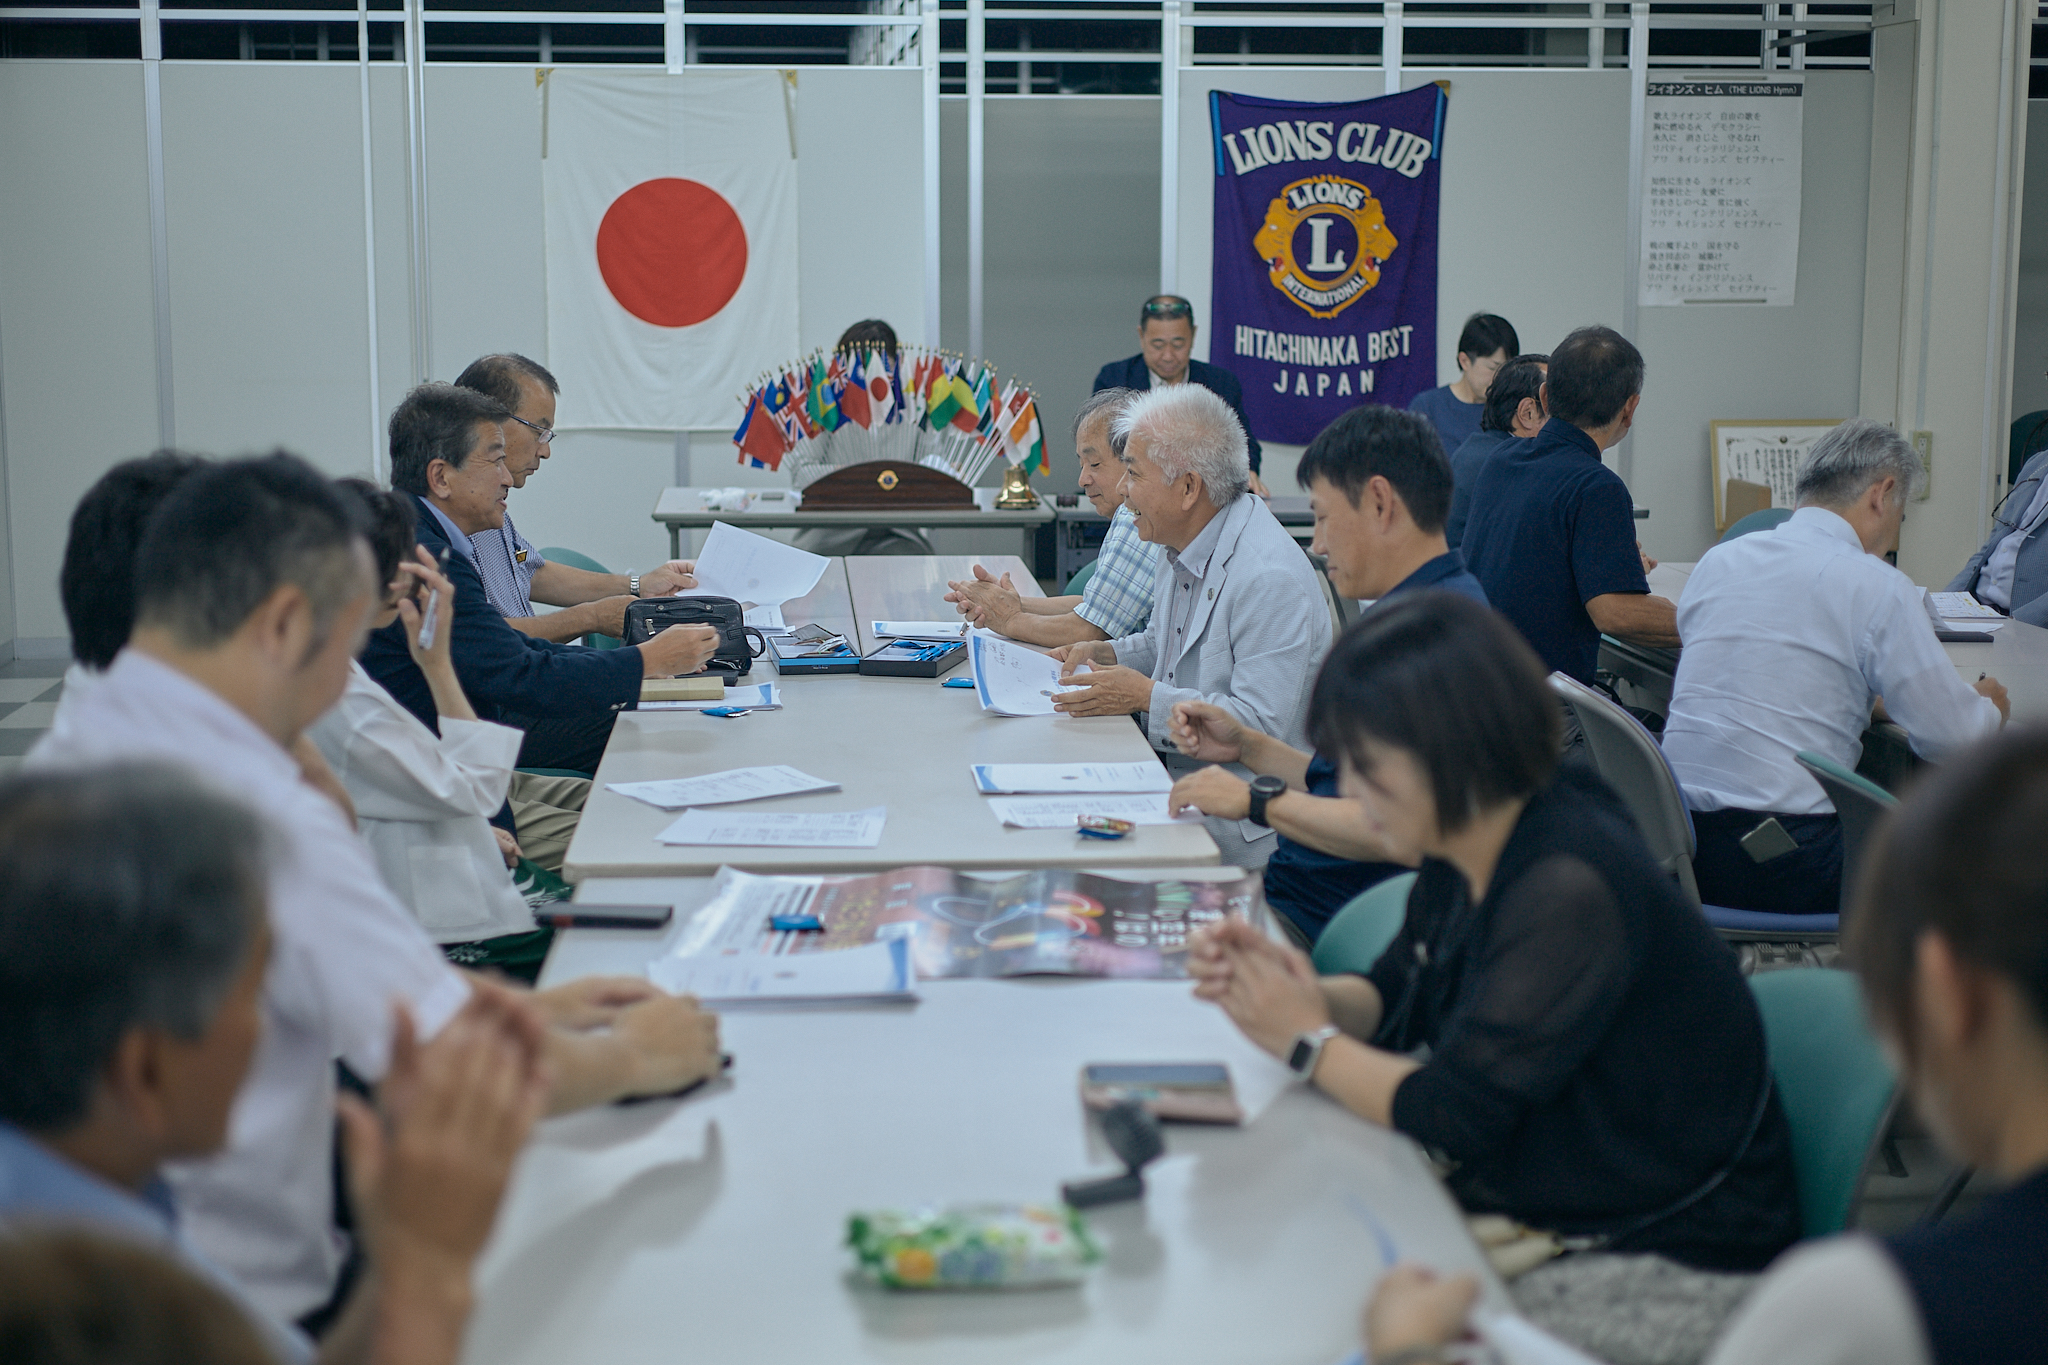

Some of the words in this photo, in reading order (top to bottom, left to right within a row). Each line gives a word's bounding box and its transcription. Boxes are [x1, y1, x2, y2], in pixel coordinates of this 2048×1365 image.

[1648, 84, 1724, 95] ライオンズ・ヒム
[1749, 85, 1771, 94] LIONS
[1653, 111, 1712, 121] 歌えライオンズ
[1720, 111, 1762, 121] 自由の歌を
[1711, 122, 1762, 131] デモクラシー
[1222, 120, 1334, 176] LIONS
[1336, 121, 1433, 179] CLUB
[1695, 144, 1760, 153] インテリジェンス
[1677, 155, 1727, 164] ネイションズ
[1710, 177, 1752, 186] ライオンズ
[1288, 181, 1367, 211] LIONS
[1693, 209, 1759, 218] インテリジェンス
[1306, 217, 1348, 273] L
[1689, 274, 1754, 282] インテリジェンス
[1281, 275, 1368, 308] INTERNATIONAL
[1234, 324, 1360, 368] HITACHINAKA
[1366, 325, 1414, 363] BEST
[1273, 368, 1375, 398] JAPAN
